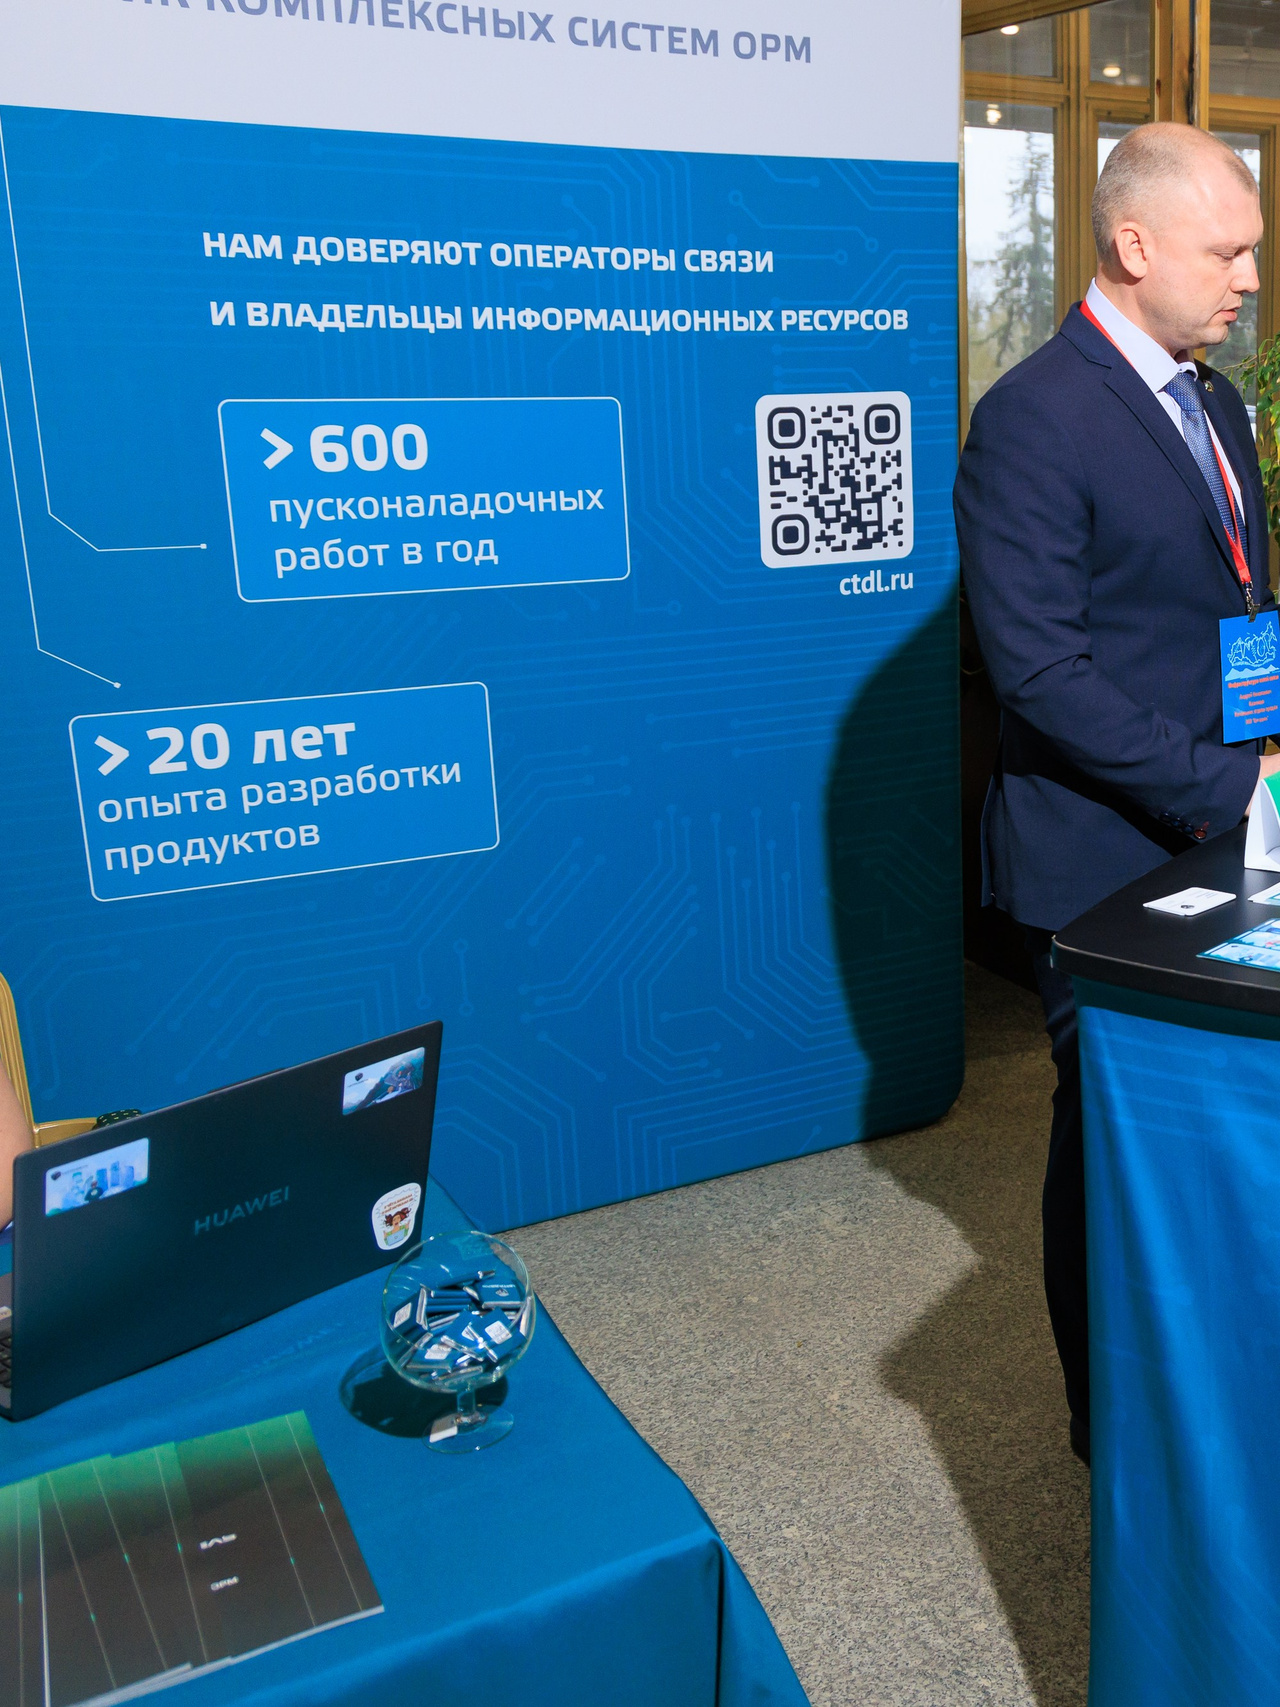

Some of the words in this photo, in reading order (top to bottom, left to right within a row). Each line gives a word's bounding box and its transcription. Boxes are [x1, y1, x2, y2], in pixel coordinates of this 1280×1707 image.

[568, 16, 719, 57] СИСТЕМ
[733, 31, 812, 63] ОРМ
[203, 232, 283, 260] НАМ
[292, 235, 483, 266] ДОВЕРЯЮТ
[490, 242, 676, 272] ОПЕРАТОРЫ
[683, 249, 774, 273] СВЯЗИ
[210, 301, 236, 326] И
[246, 302, 463, 334] ВЛАДЕЛЬЦЫ
[472, 306, 774, 336] ИНФОРМАЦИОННЫХ
[781, 309, 909, 331] РЕСУРСОВ
[309, 423, 429, 473] 600
[269, 488, 605, 529] пусконаладочных
[274, 538, 390, 579] работ
[402, 543, 423, 565] в
[435, 538, 499, 566] год
[839, 569, 914, 596] ctdl.ru
[146, 723, 231, 775] 20
[252, 722, 357, 765] лет
[98, 784, 228, 823] опыта
[241, 762, 462, 813] разработки
[105, 823, 321, 874] продуктов
[194, 1185, 289, 1235] HUAWEI
